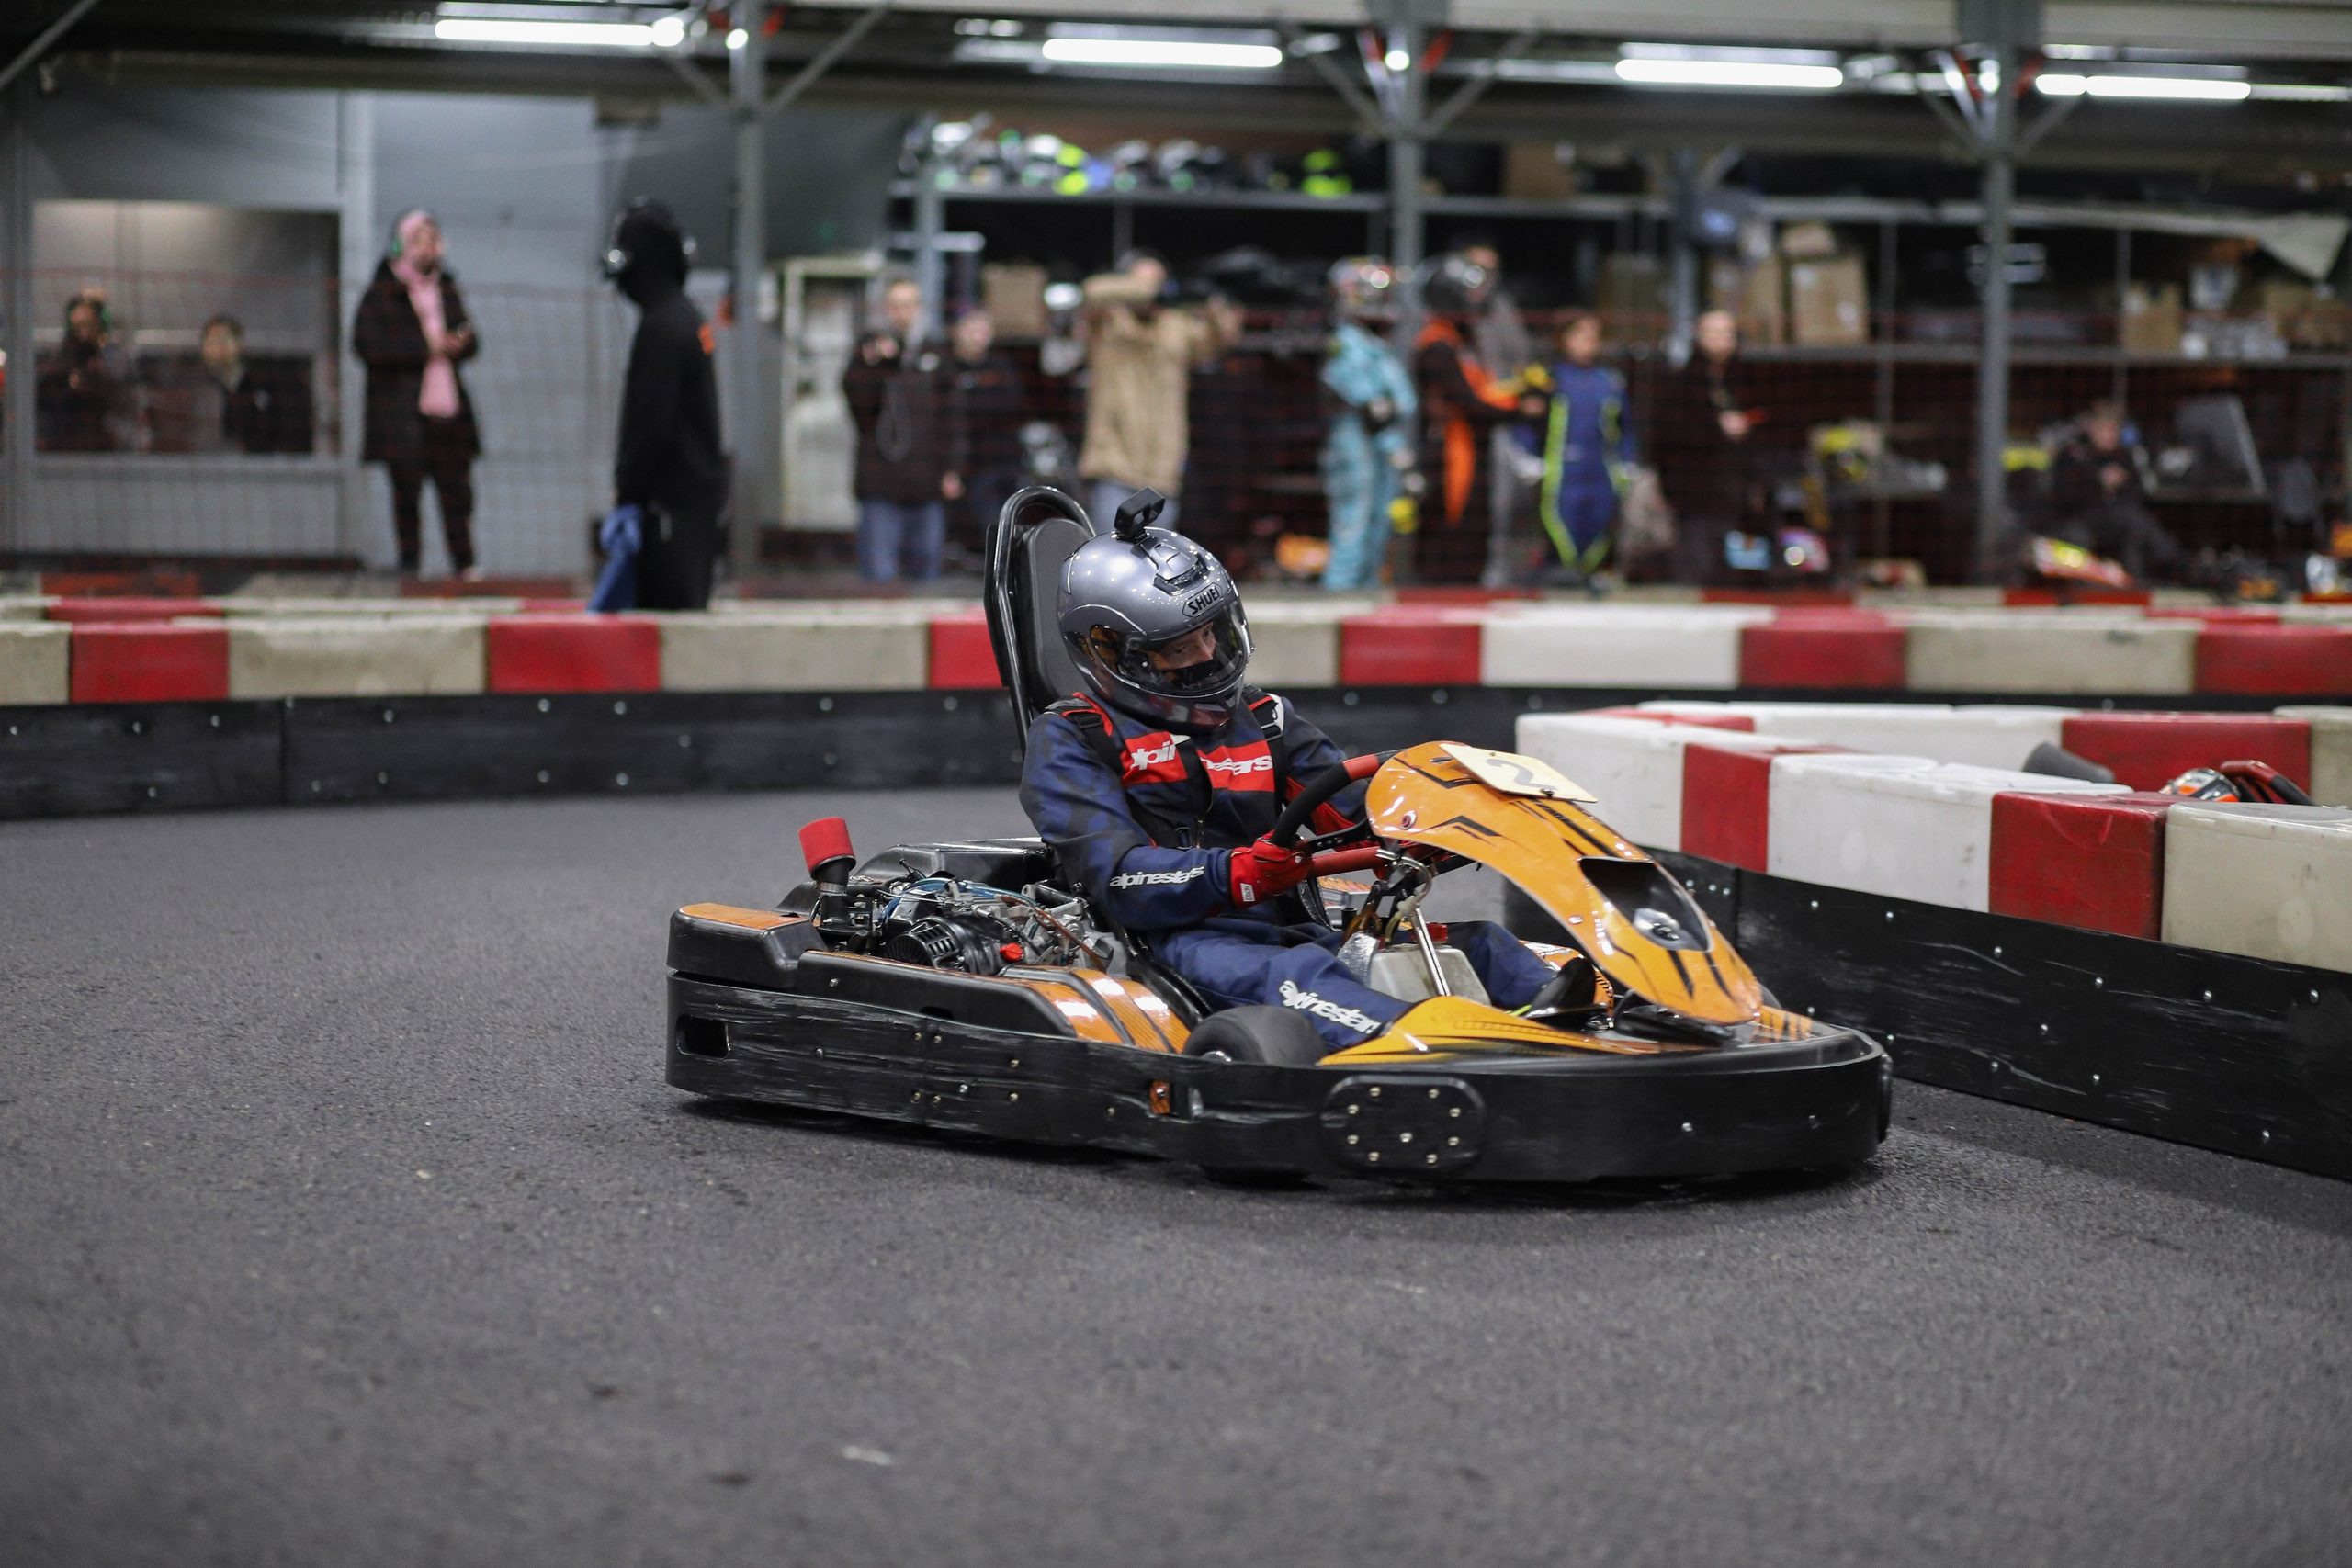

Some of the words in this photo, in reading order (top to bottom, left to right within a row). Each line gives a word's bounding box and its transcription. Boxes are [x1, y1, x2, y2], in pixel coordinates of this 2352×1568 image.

[1486, 759, 1558, 791] 2
[1109, 866, 1204, 889] alpinestas
[1278, 980, 1382, 1034] apinestar
